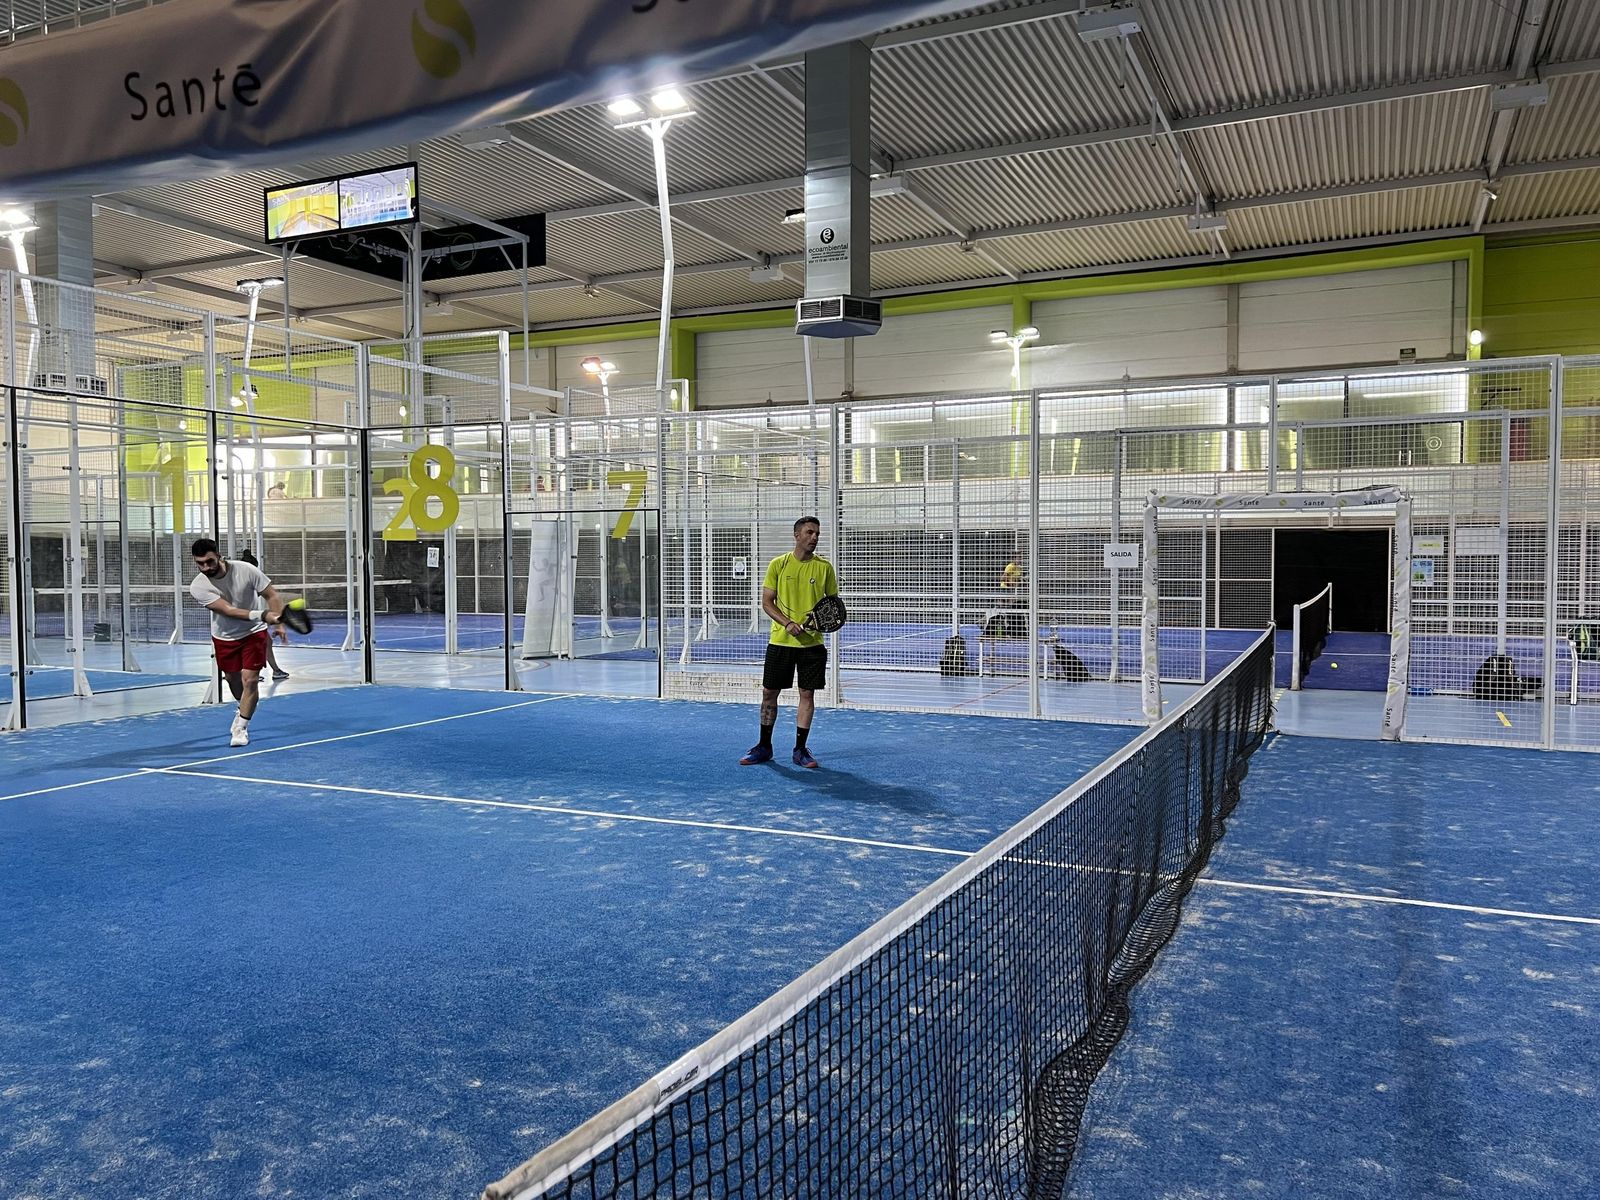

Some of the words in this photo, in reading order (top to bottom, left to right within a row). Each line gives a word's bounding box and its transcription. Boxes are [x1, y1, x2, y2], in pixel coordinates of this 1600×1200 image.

[808, 243, 848, 253] ecoambiental
[410, 444, 459, 532] 8
[607, 470, 647, 539] 7
